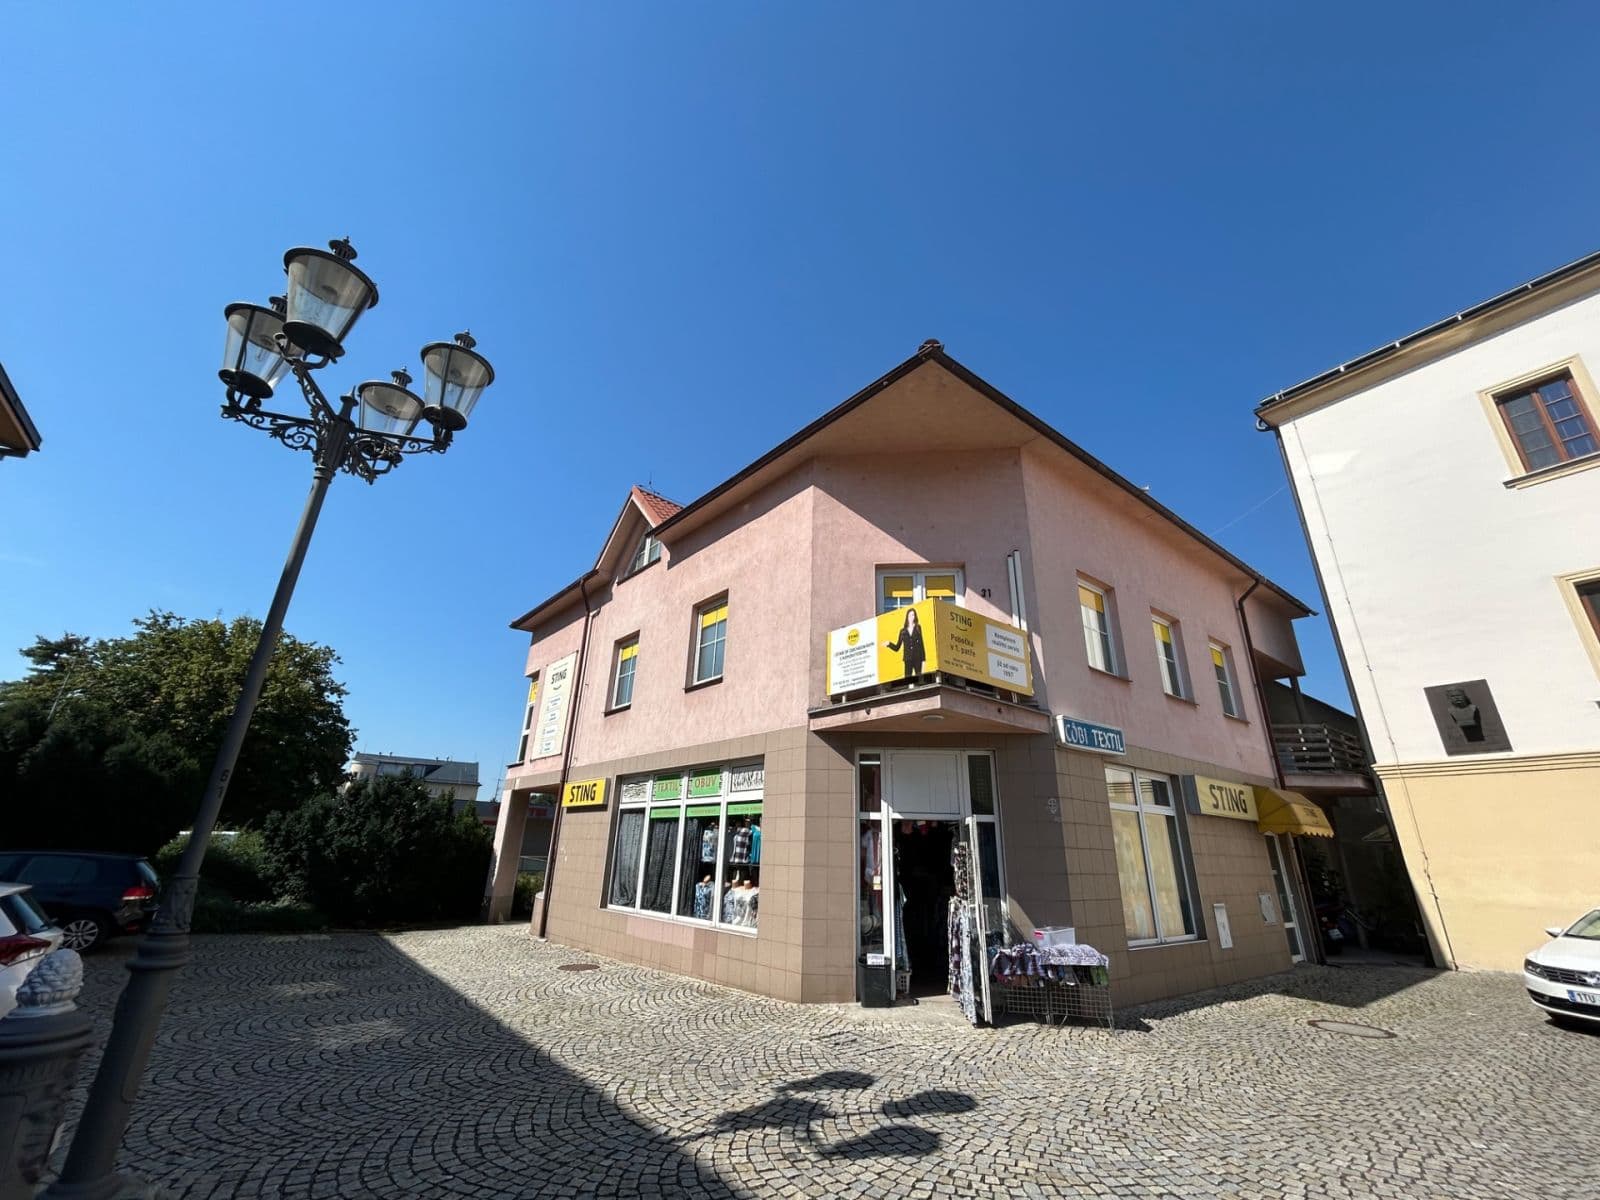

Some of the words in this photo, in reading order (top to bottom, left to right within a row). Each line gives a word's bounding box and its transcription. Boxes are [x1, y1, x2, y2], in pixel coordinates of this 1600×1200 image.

[950, 611, 973, 627] STING
[551, 668, 568, 685] STING
[1091, 729, 1124, 752] TEXTIL
[657, 780, 679, 792] TEXTIL
[694, 775, 718, 789] OBUV
[569, 782, 597, 803] STING
[1209, 783, 1249, 814] STING
